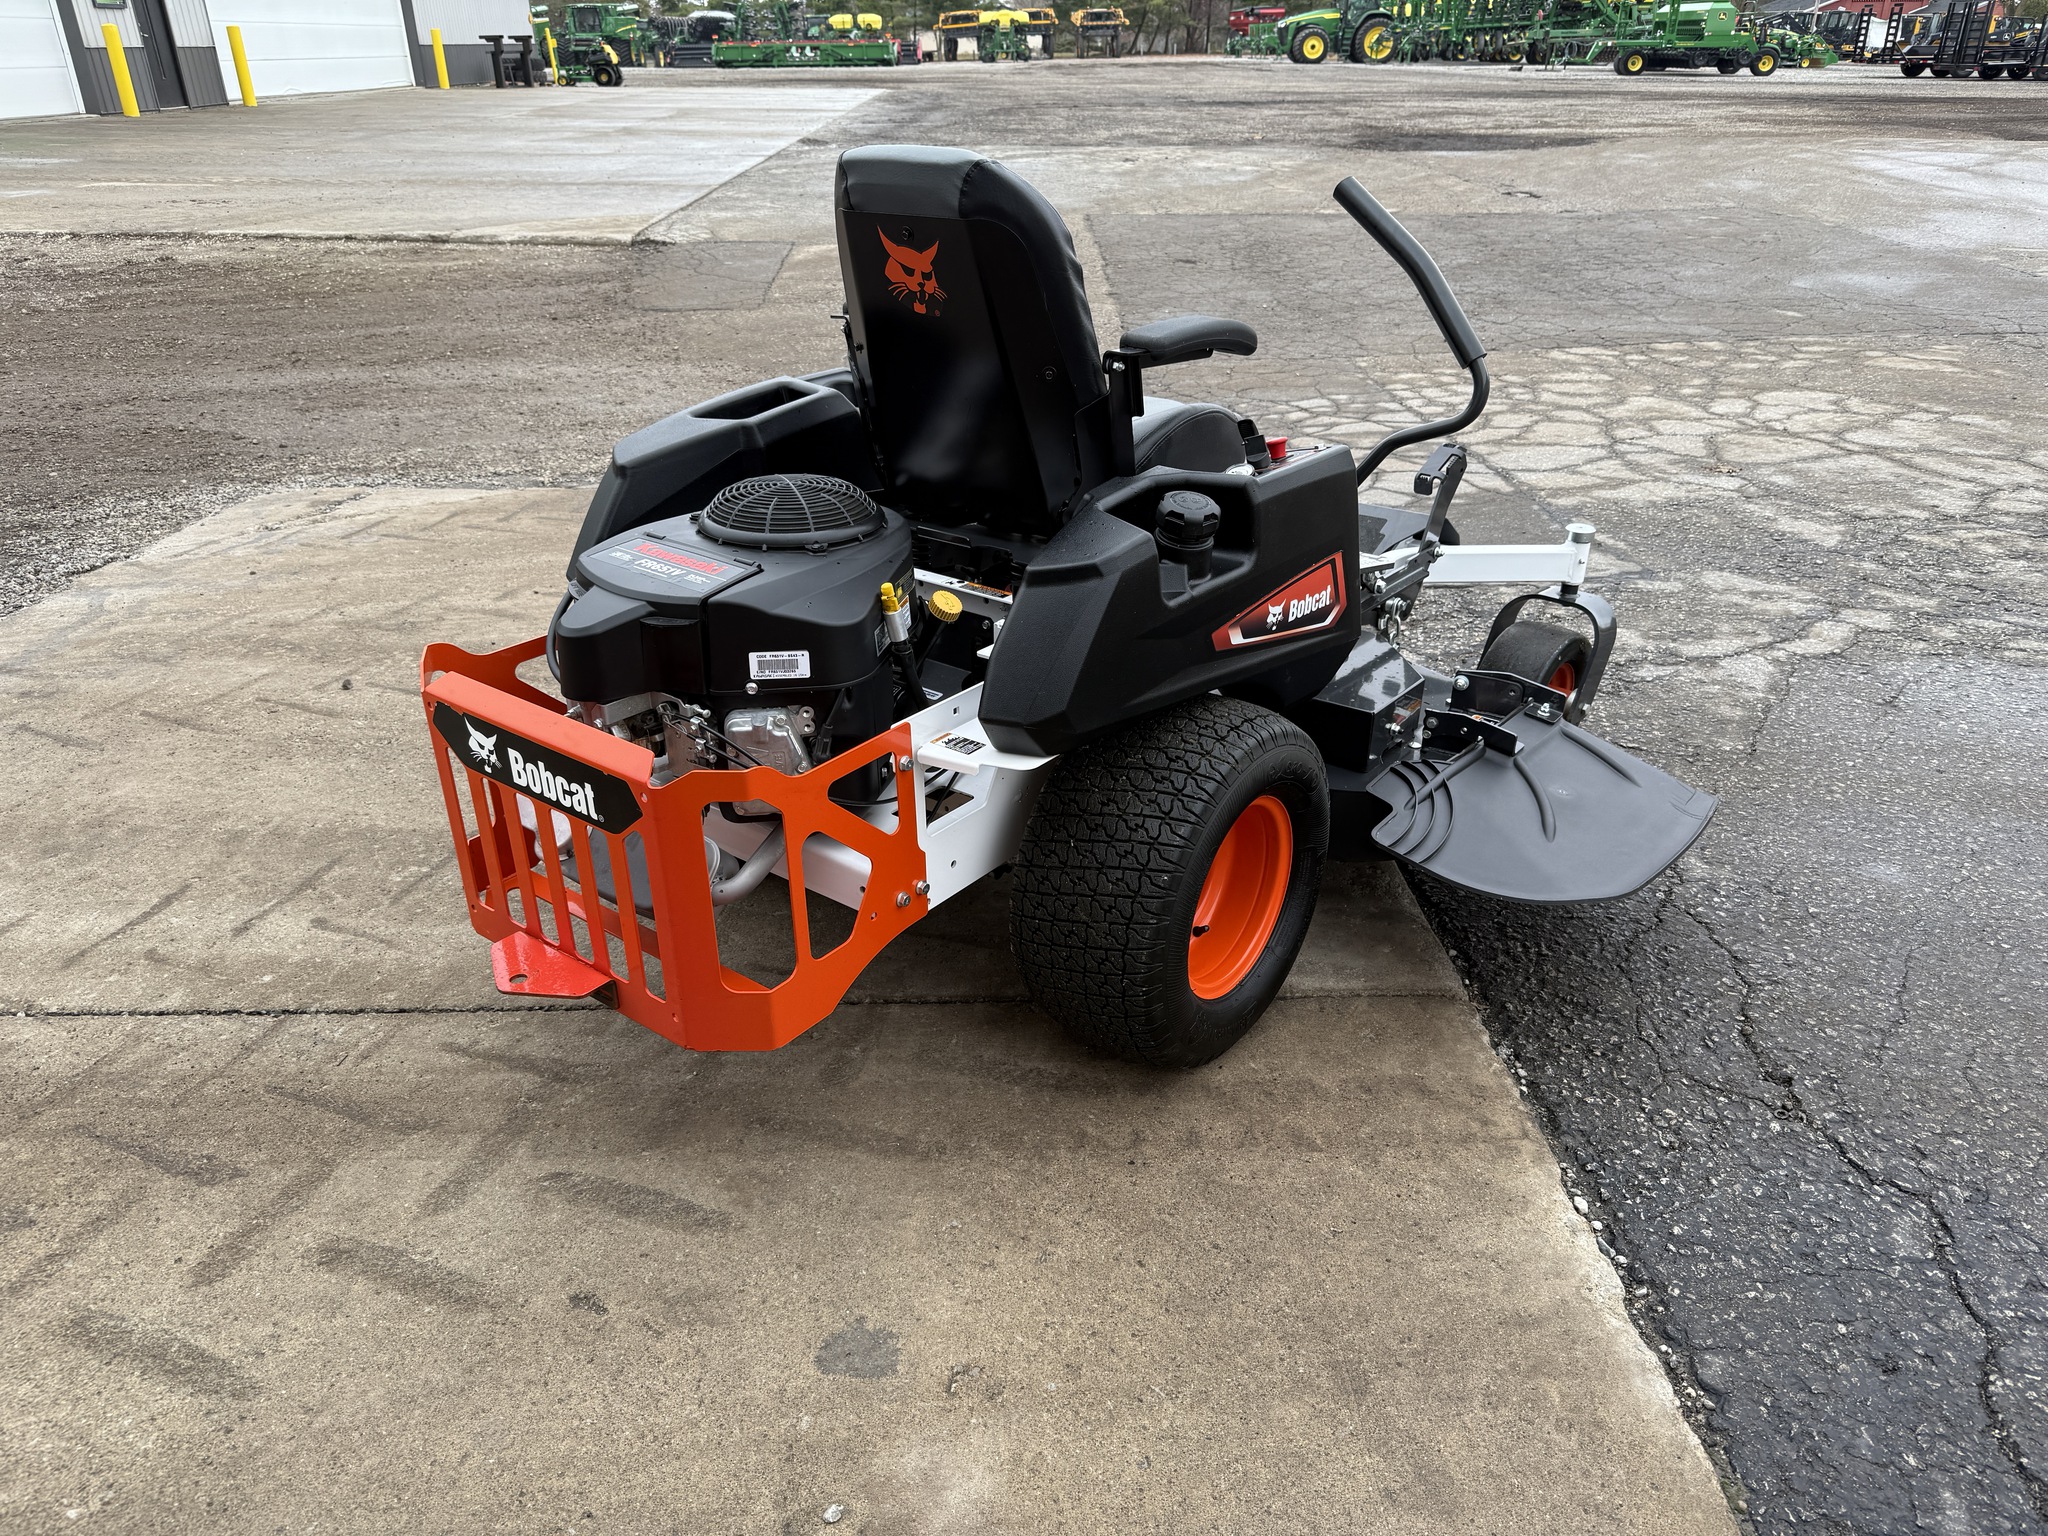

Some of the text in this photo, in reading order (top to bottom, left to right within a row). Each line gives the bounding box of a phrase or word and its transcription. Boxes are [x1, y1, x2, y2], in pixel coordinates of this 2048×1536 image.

[633, 543, 729, 576] Kawasaki
[634, 558, 687, 576] FR651V
[1287, 584, 1332, 623] Bobcat
[507, 747, 599, 821] Bobcat
